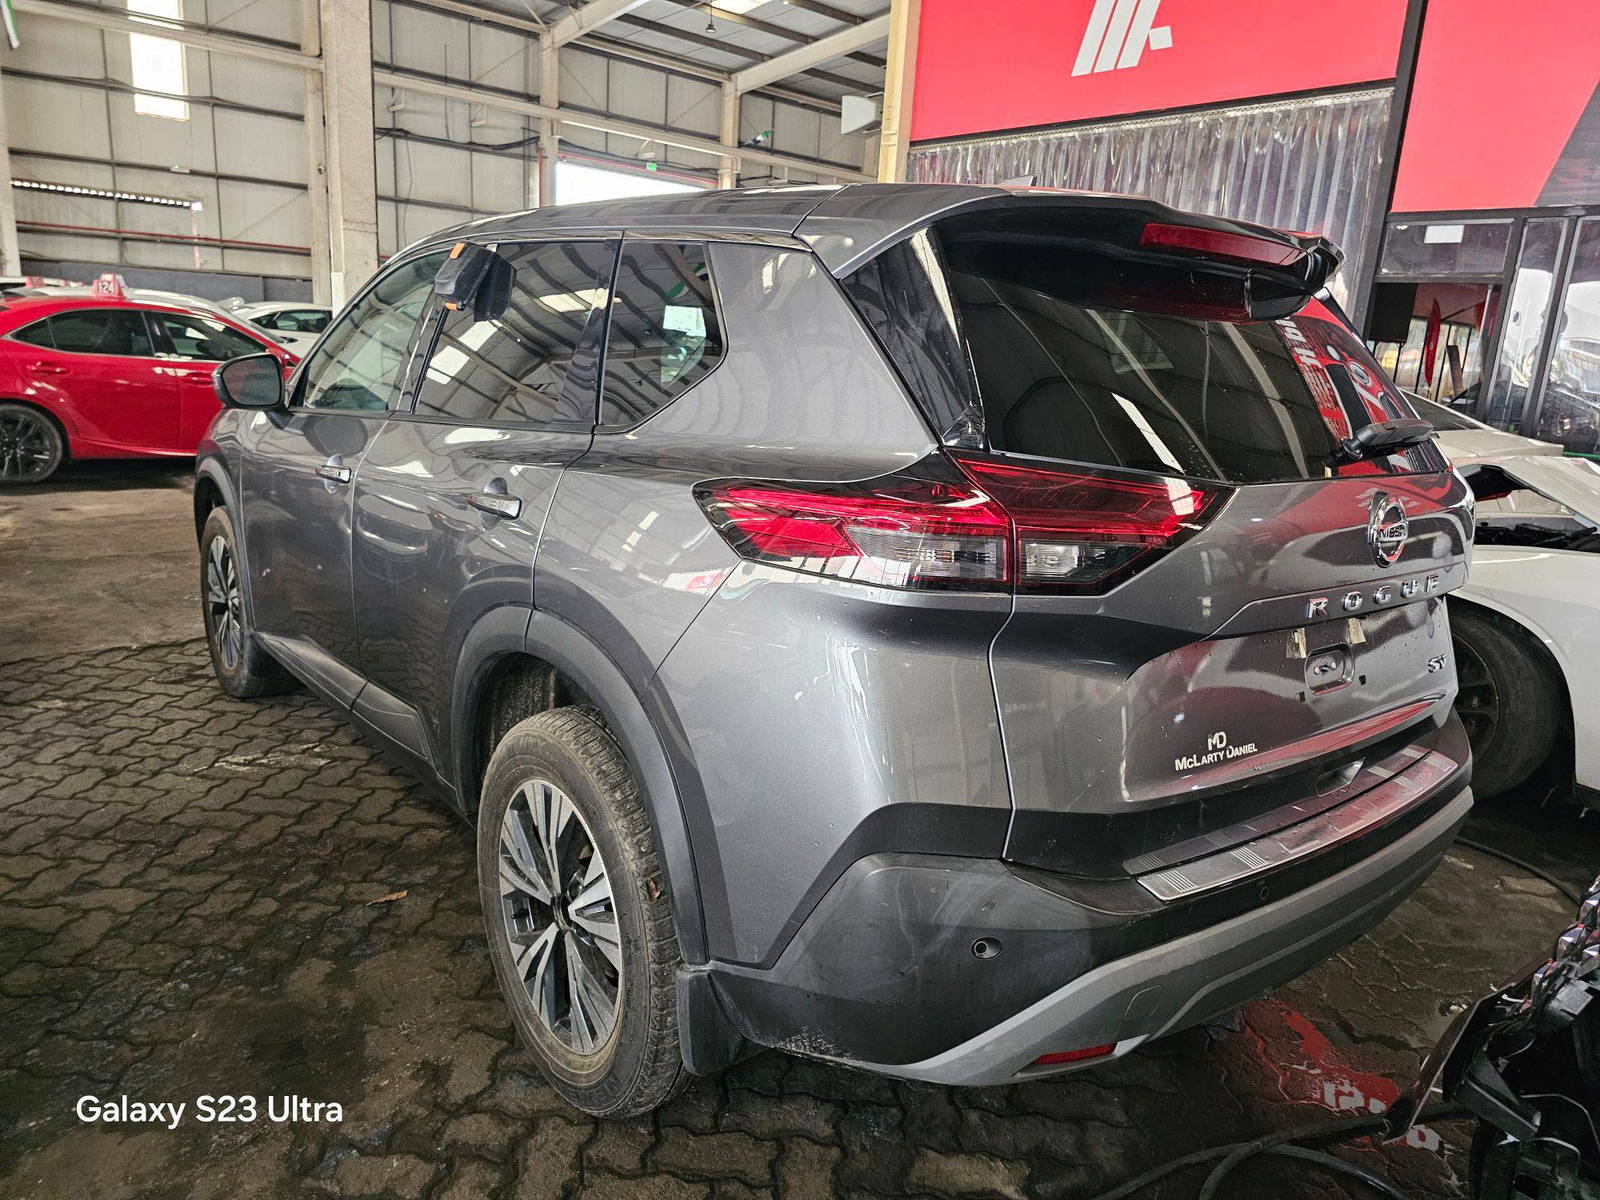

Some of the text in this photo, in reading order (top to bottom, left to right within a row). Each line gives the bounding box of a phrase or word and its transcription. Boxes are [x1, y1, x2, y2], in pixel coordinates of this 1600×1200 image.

[1377, 524, 1407, 540] NISS
[1306, 573, 1441, 619] ROGUE
[1226, 742, 1258, 759] DANIEL
